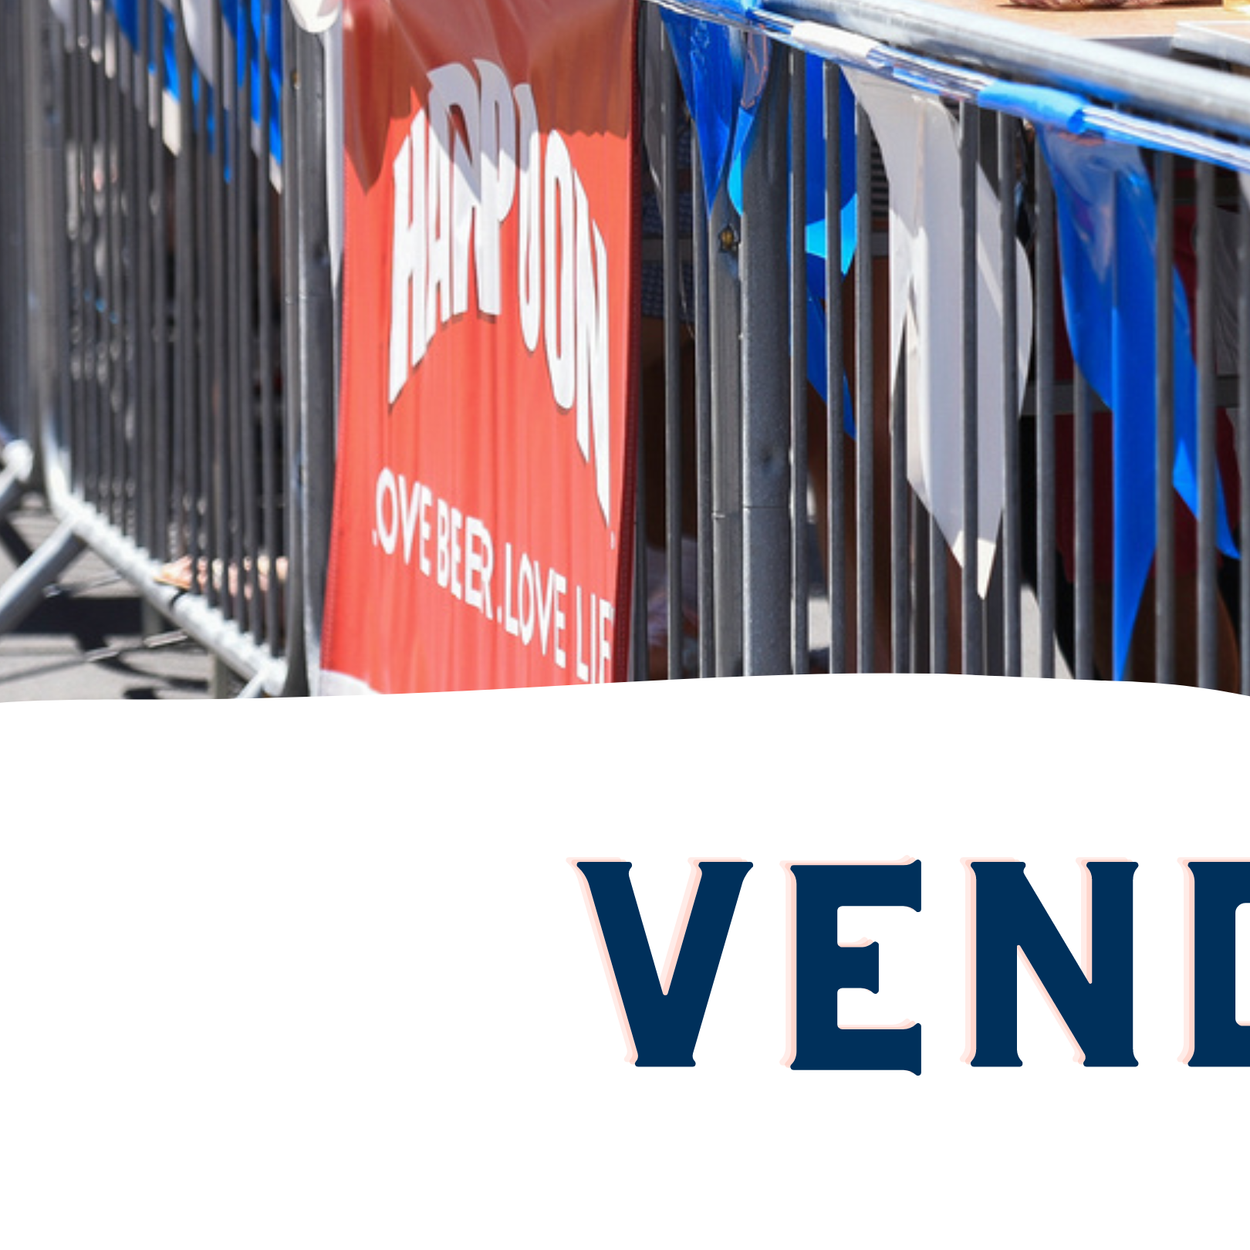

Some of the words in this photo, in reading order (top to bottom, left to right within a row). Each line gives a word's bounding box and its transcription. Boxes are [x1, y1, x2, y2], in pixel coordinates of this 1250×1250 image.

[373, 466, 431, 577] OVE
[505, 542, 566, 669] LOVE
[576, 585, 614, 684] LIF
